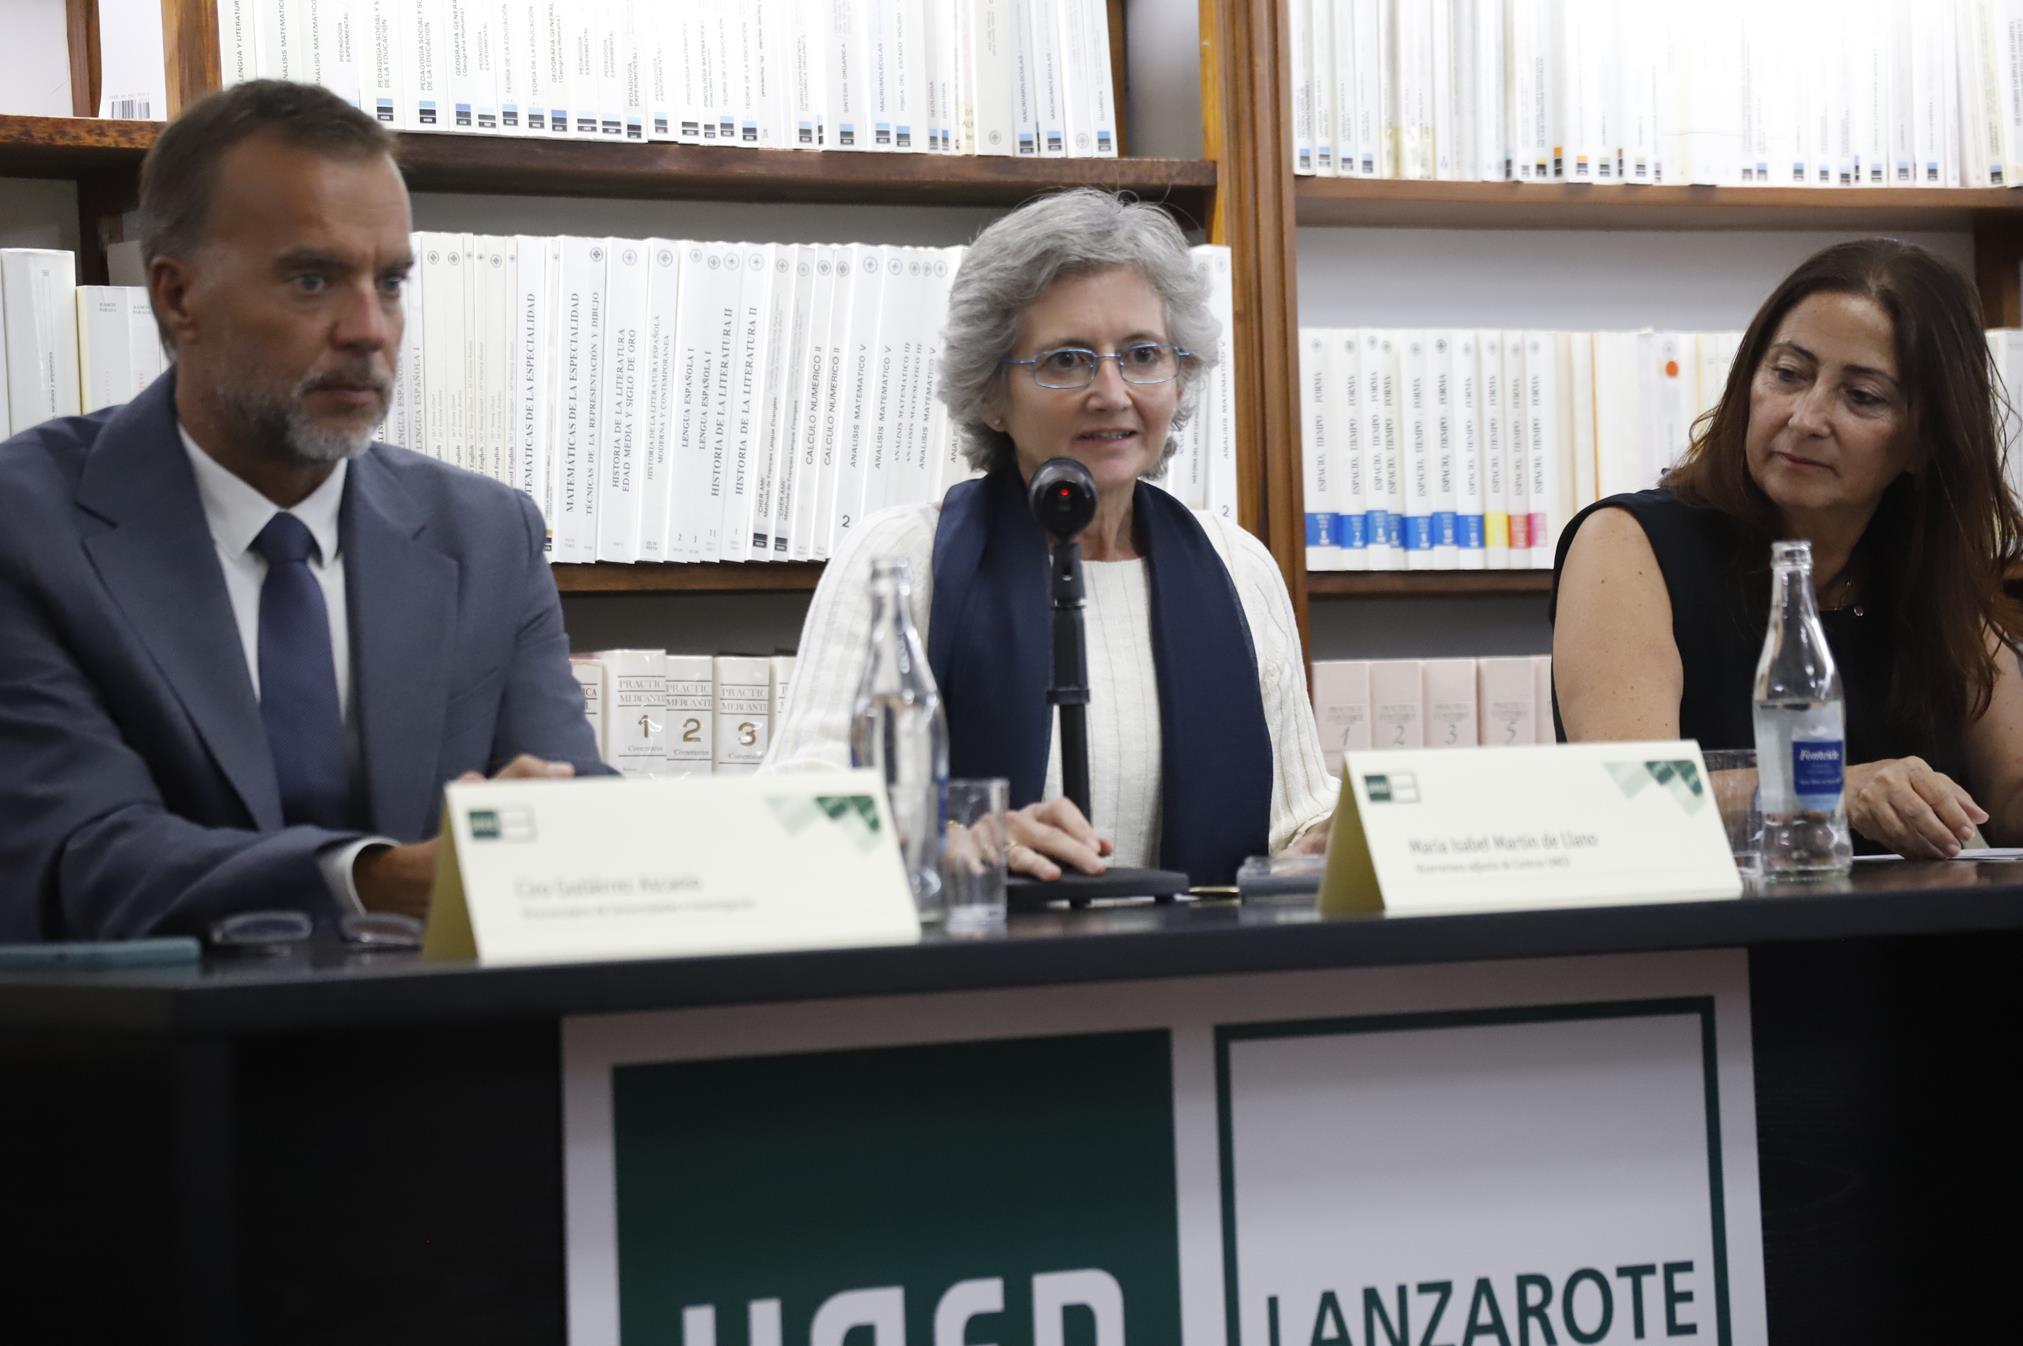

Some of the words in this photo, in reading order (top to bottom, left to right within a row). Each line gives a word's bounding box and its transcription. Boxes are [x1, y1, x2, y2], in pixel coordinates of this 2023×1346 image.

[383, 67, 389, 76] LA
[384, 77, 390, 88] DE
[426, 69, 432, 78] LA
[427, 80, 432, 91] DE
[591, 292, 599, 327] DIBUJO
[723, 308, 732, 317] II
[749, 306, 757, 316] II
[525, 293, 536, 381] ESPECIALIDAD
[569, 293, 580, 381] ESPECIALIDAD
[627, 329, 636, 353] ORO
[615, 329, 625, 396] LITERATURA
[627, 357, 635, 371] DE
[717, 321, 731, 396] LITERATURA
[741, 320, 756, 394] LITERATURA
[412, 355, 422, 405] ESPAÑOLA
[625, 376, 635, 407] SIGLO
[682, 356, 694, 405] ESPAÑOLA
[700, 358, 711, 407] ESPAÑOLA
[811, 356, 822, 411] NUMERICO
[829, 357, 840, 412] NUMERICO
[854, 356, 866, 419] MATEMATICO
[879, 357, 891, 421] MATEMATICO
[525, 385, 535, 400] LA
[568, 385, 577, 400] LA
[525, 404, 534, 421] DE
[568, 404, 577, 421] DE
[613, 401, 622, 415] LA
[716, 400, 726, 415] LA
[740, 399, 750, 414] LA
[613, 419, 621, 433] DE
[681, 409, 691, 447] LENGUA
[699, 411, 708, 450] LENGUA
[715, 419, 724, 435] DE
[739, 418, 748, 434] DE
[588, 433, 595, 446] LA
[624, 423, 632, 458] MEDIA
[806, 415, 817, 464] CALCULO
[824, 417, 835, 466] CALCULO
[850, 425, 860, 468] ANALISIS
[875, 426, 885, 469] ANALISIS
[919, 427, 929, 469] ANALISIS
[523, 424, 535, 497] TEMÁTICAS
[564, 423, 577, 512] MATEMÁTICAS
[587, 450, 594, 463] DE
[612, 438, 621, 488] HISTORIA
[711, 439, 723, 496] HISTORIA
[735, 440, 747, 495] HISTORIA
[623, 462, 631, 492] EDAD
[841, 515, 851, 528] 2
[1222, 505, 1229, 517] 2
[619, 679, 663, 689] PRACTIC
[666, 685, 709, 693] PRACTIC
[721, 688, 766, 697] PRACTIC
[619, 694, 665, 705] MERCANTI
[666, 698, 712, 707] MERCANTI
[721, 703, 768, 712] MERCANTI
[638, 714, 649, 738] 1
[682, 718, 701, 742] 2
[738, 722, 756, 746] 3
[1343, 726, 1350, 746] 1
[1393, 725, 1405, 745] 2
[1445, 720, 1457, 745] 3
[1504, 720, 1517, 744] 5
